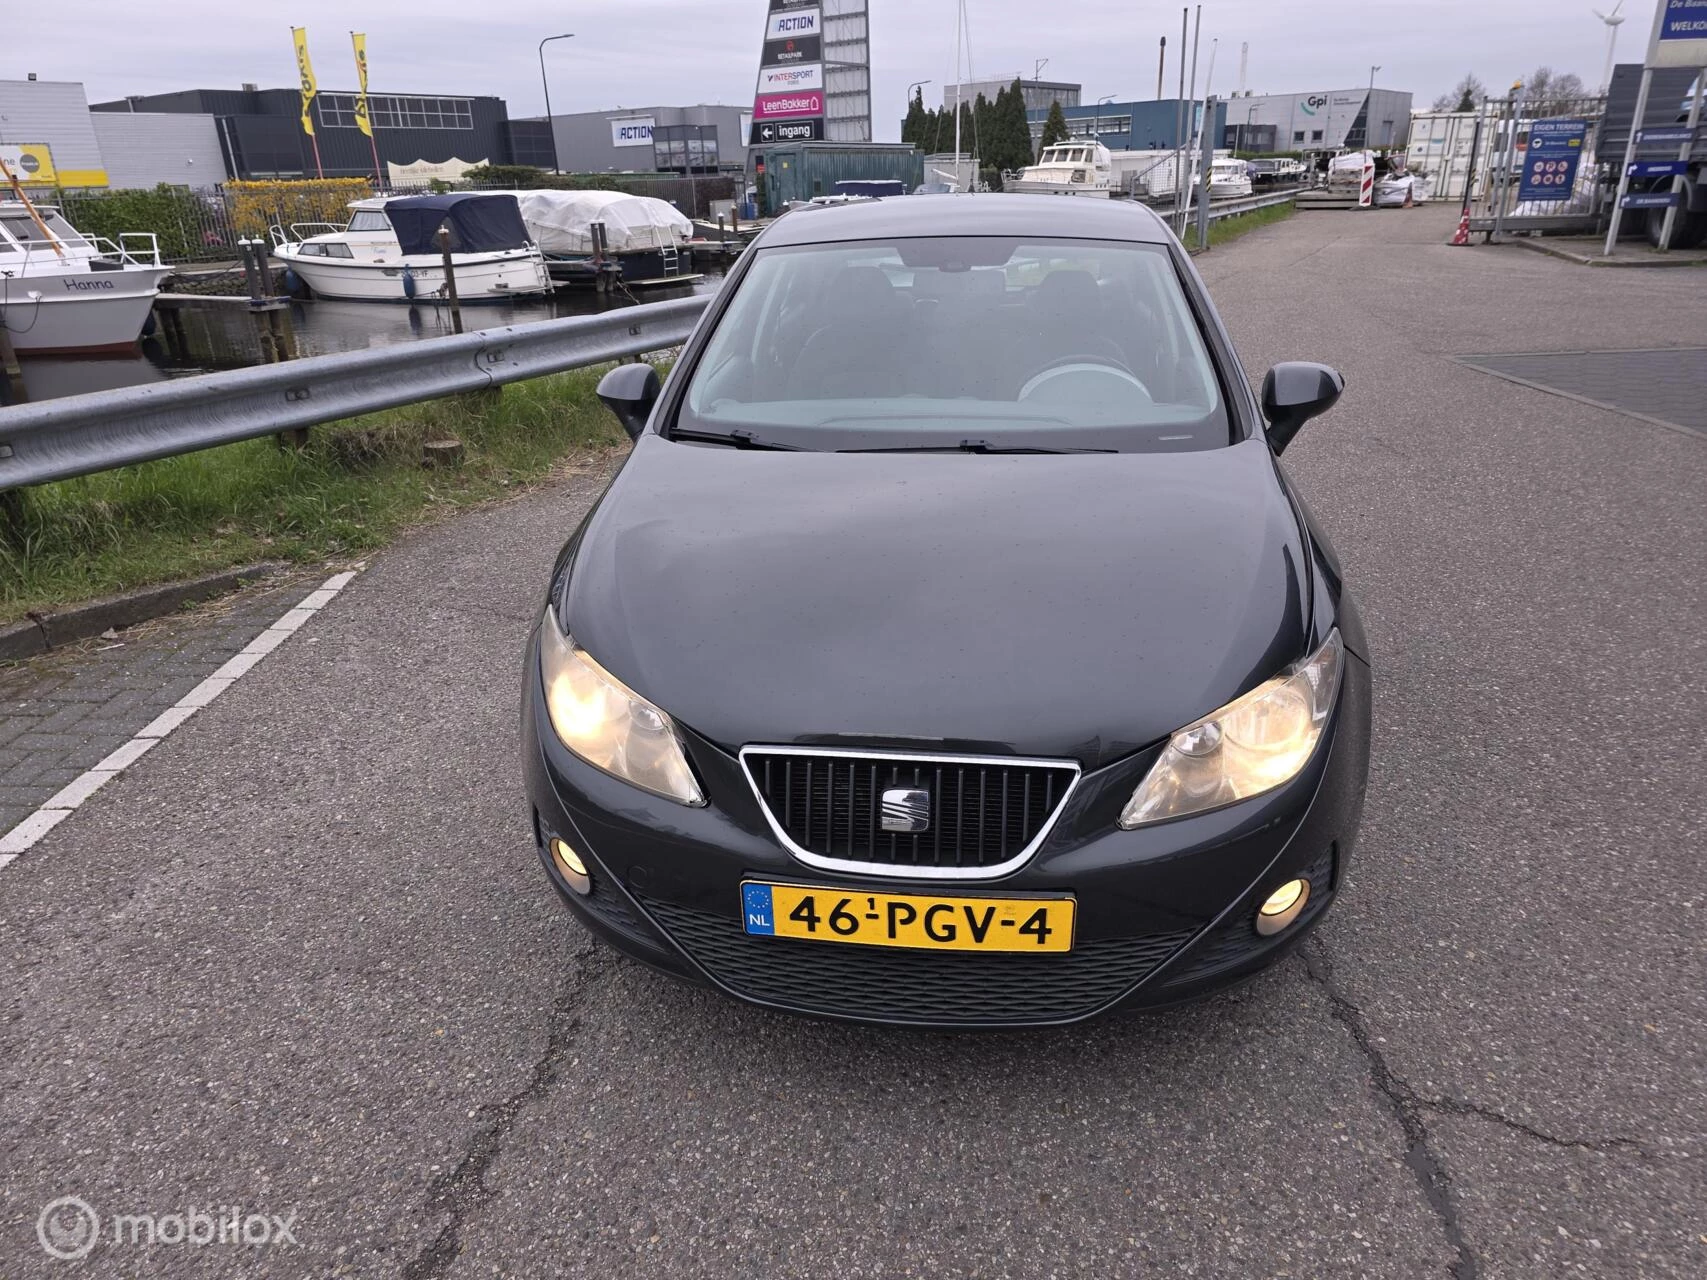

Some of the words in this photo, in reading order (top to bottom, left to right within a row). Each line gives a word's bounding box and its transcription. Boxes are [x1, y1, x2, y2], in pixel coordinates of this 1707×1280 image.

[779, 16, 814, 32] ACTION
[774, 70, 814, 81] INTERSPORT
[762, 98, 810, 112] LeenBakker
[1307, 94, 1328, 109] Gpi
[620, 126, 653, 140] ACTION
[778, 125, 811, 138] ingang
[63, 279, 114, 291] Hanna
[749, 913, 770, 927] NL
